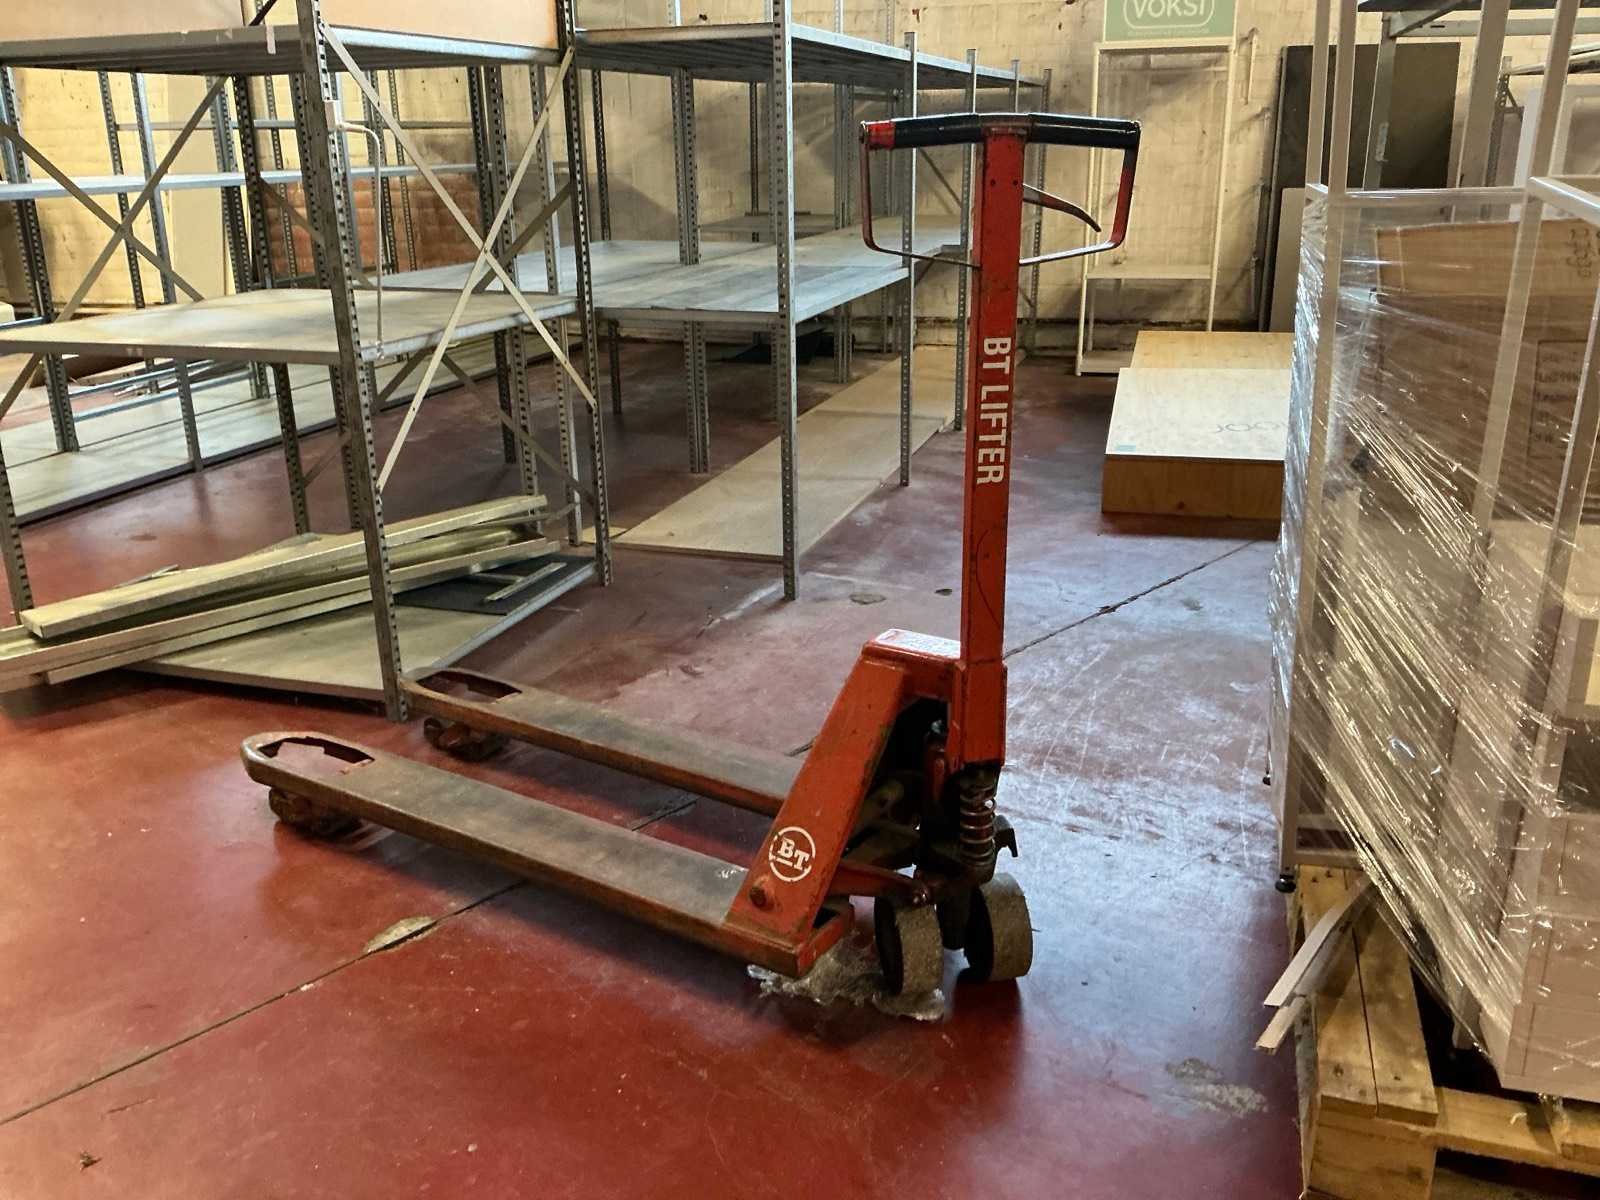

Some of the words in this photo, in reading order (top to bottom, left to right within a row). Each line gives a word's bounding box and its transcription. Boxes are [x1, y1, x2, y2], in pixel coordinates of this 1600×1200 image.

[1133, 0, 1205, 18] VOKSI
[982, 337, 1012, 374] BT
[977, 385, 1009, 484] LIFTER
[777, 836, 811, 871] BT
